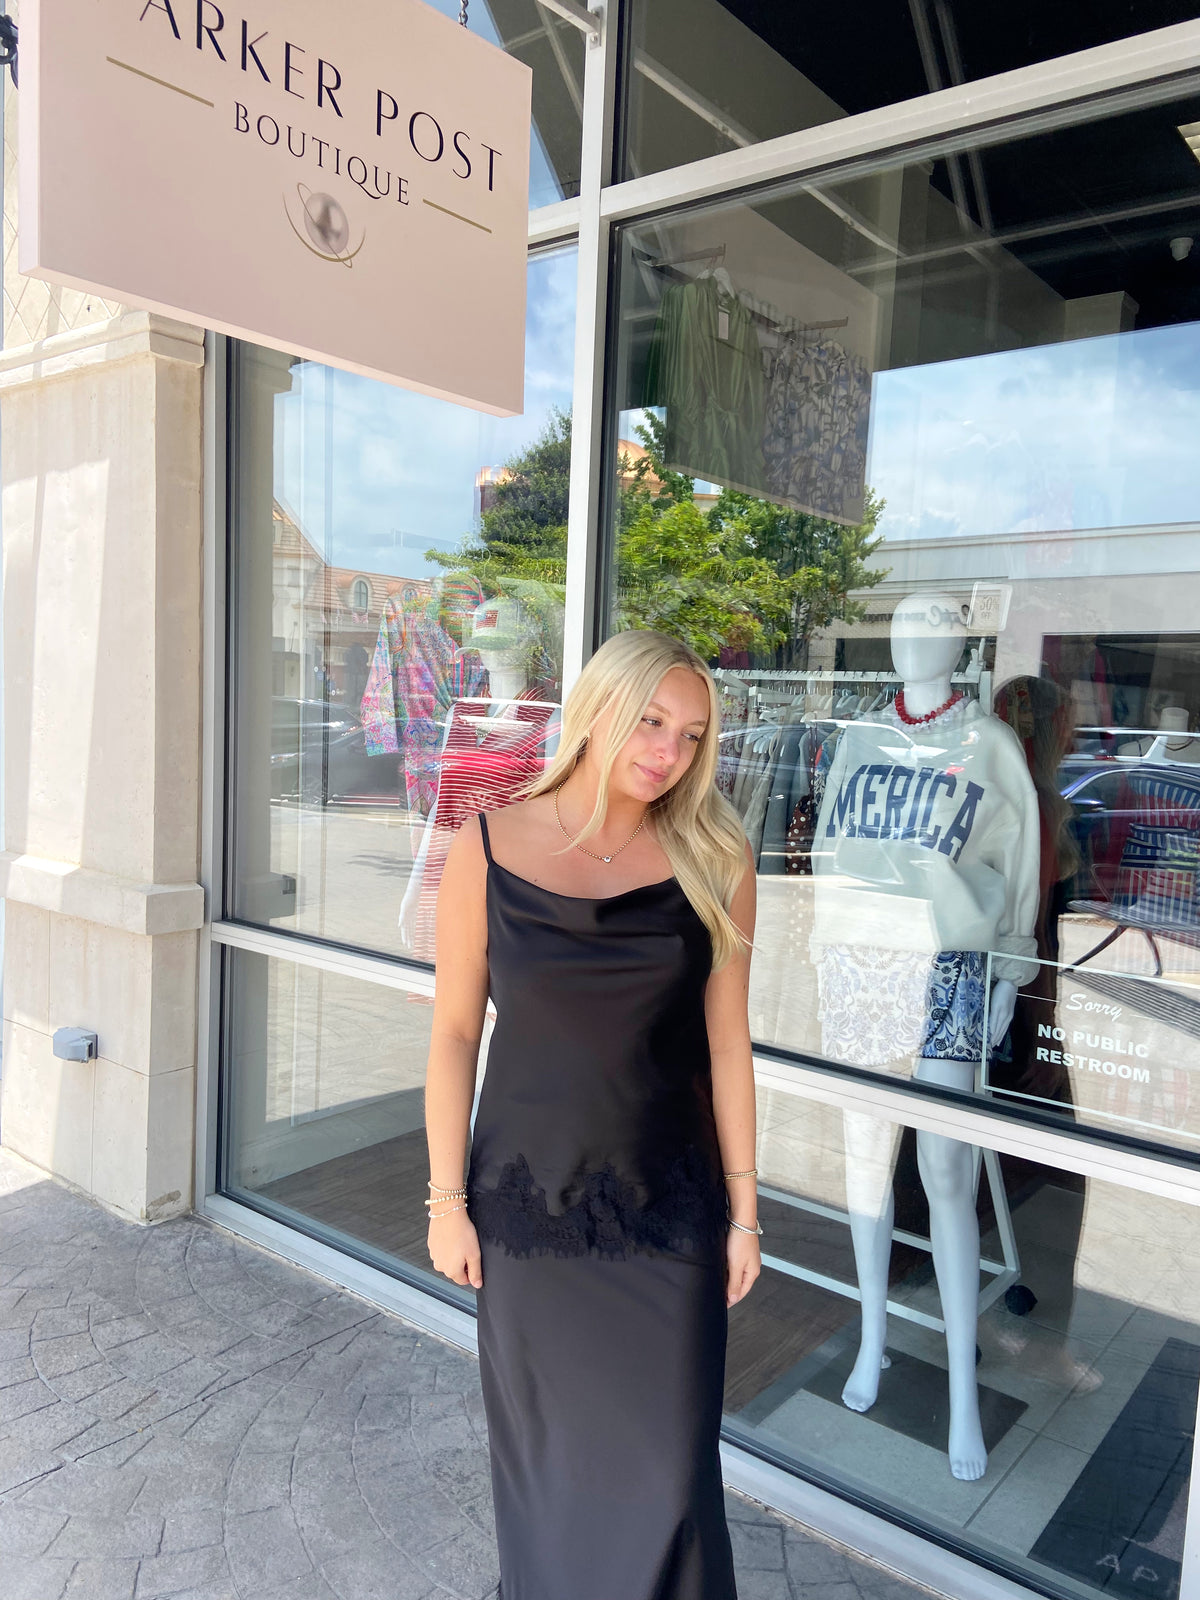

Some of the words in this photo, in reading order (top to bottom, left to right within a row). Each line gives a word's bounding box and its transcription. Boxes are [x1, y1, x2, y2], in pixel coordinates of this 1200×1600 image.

[233, 101, 410, 206] BOUTIQUE
[376, 89, 502, 191] POST
[826, 764, 985, 864] MERICA
[1037, 1023, 1066, 1041] NO
[1072, 1030, 1150, 1058] PUBLIC
[1066, 993, 1122, 1022] Sorry
[1036, 1046, 1150, 1084] RESTROOM
